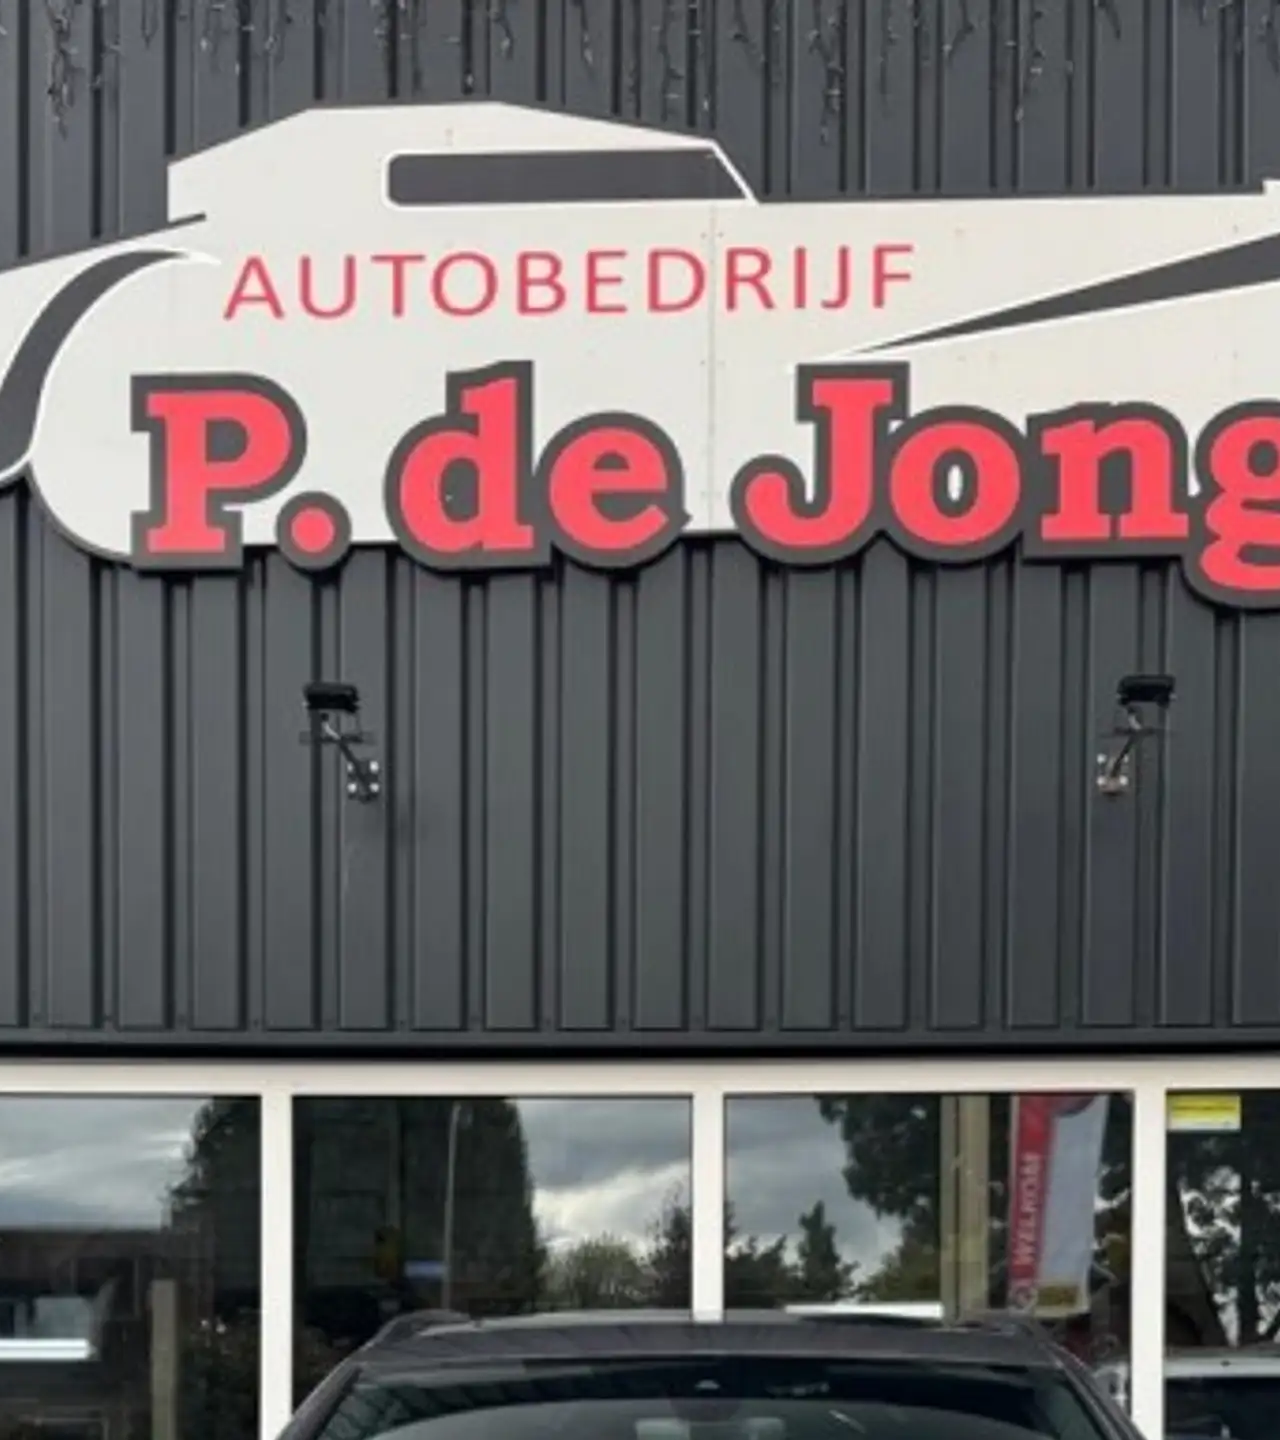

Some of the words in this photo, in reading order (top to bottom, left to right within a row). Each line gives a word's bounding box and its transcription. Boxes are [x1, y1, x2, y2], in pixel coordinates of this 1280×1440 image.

[224, 244, 913, 319] AUTOBEDRIJF
[141, 383, 341, 560] P.
[392, 370, 676, 561] de
